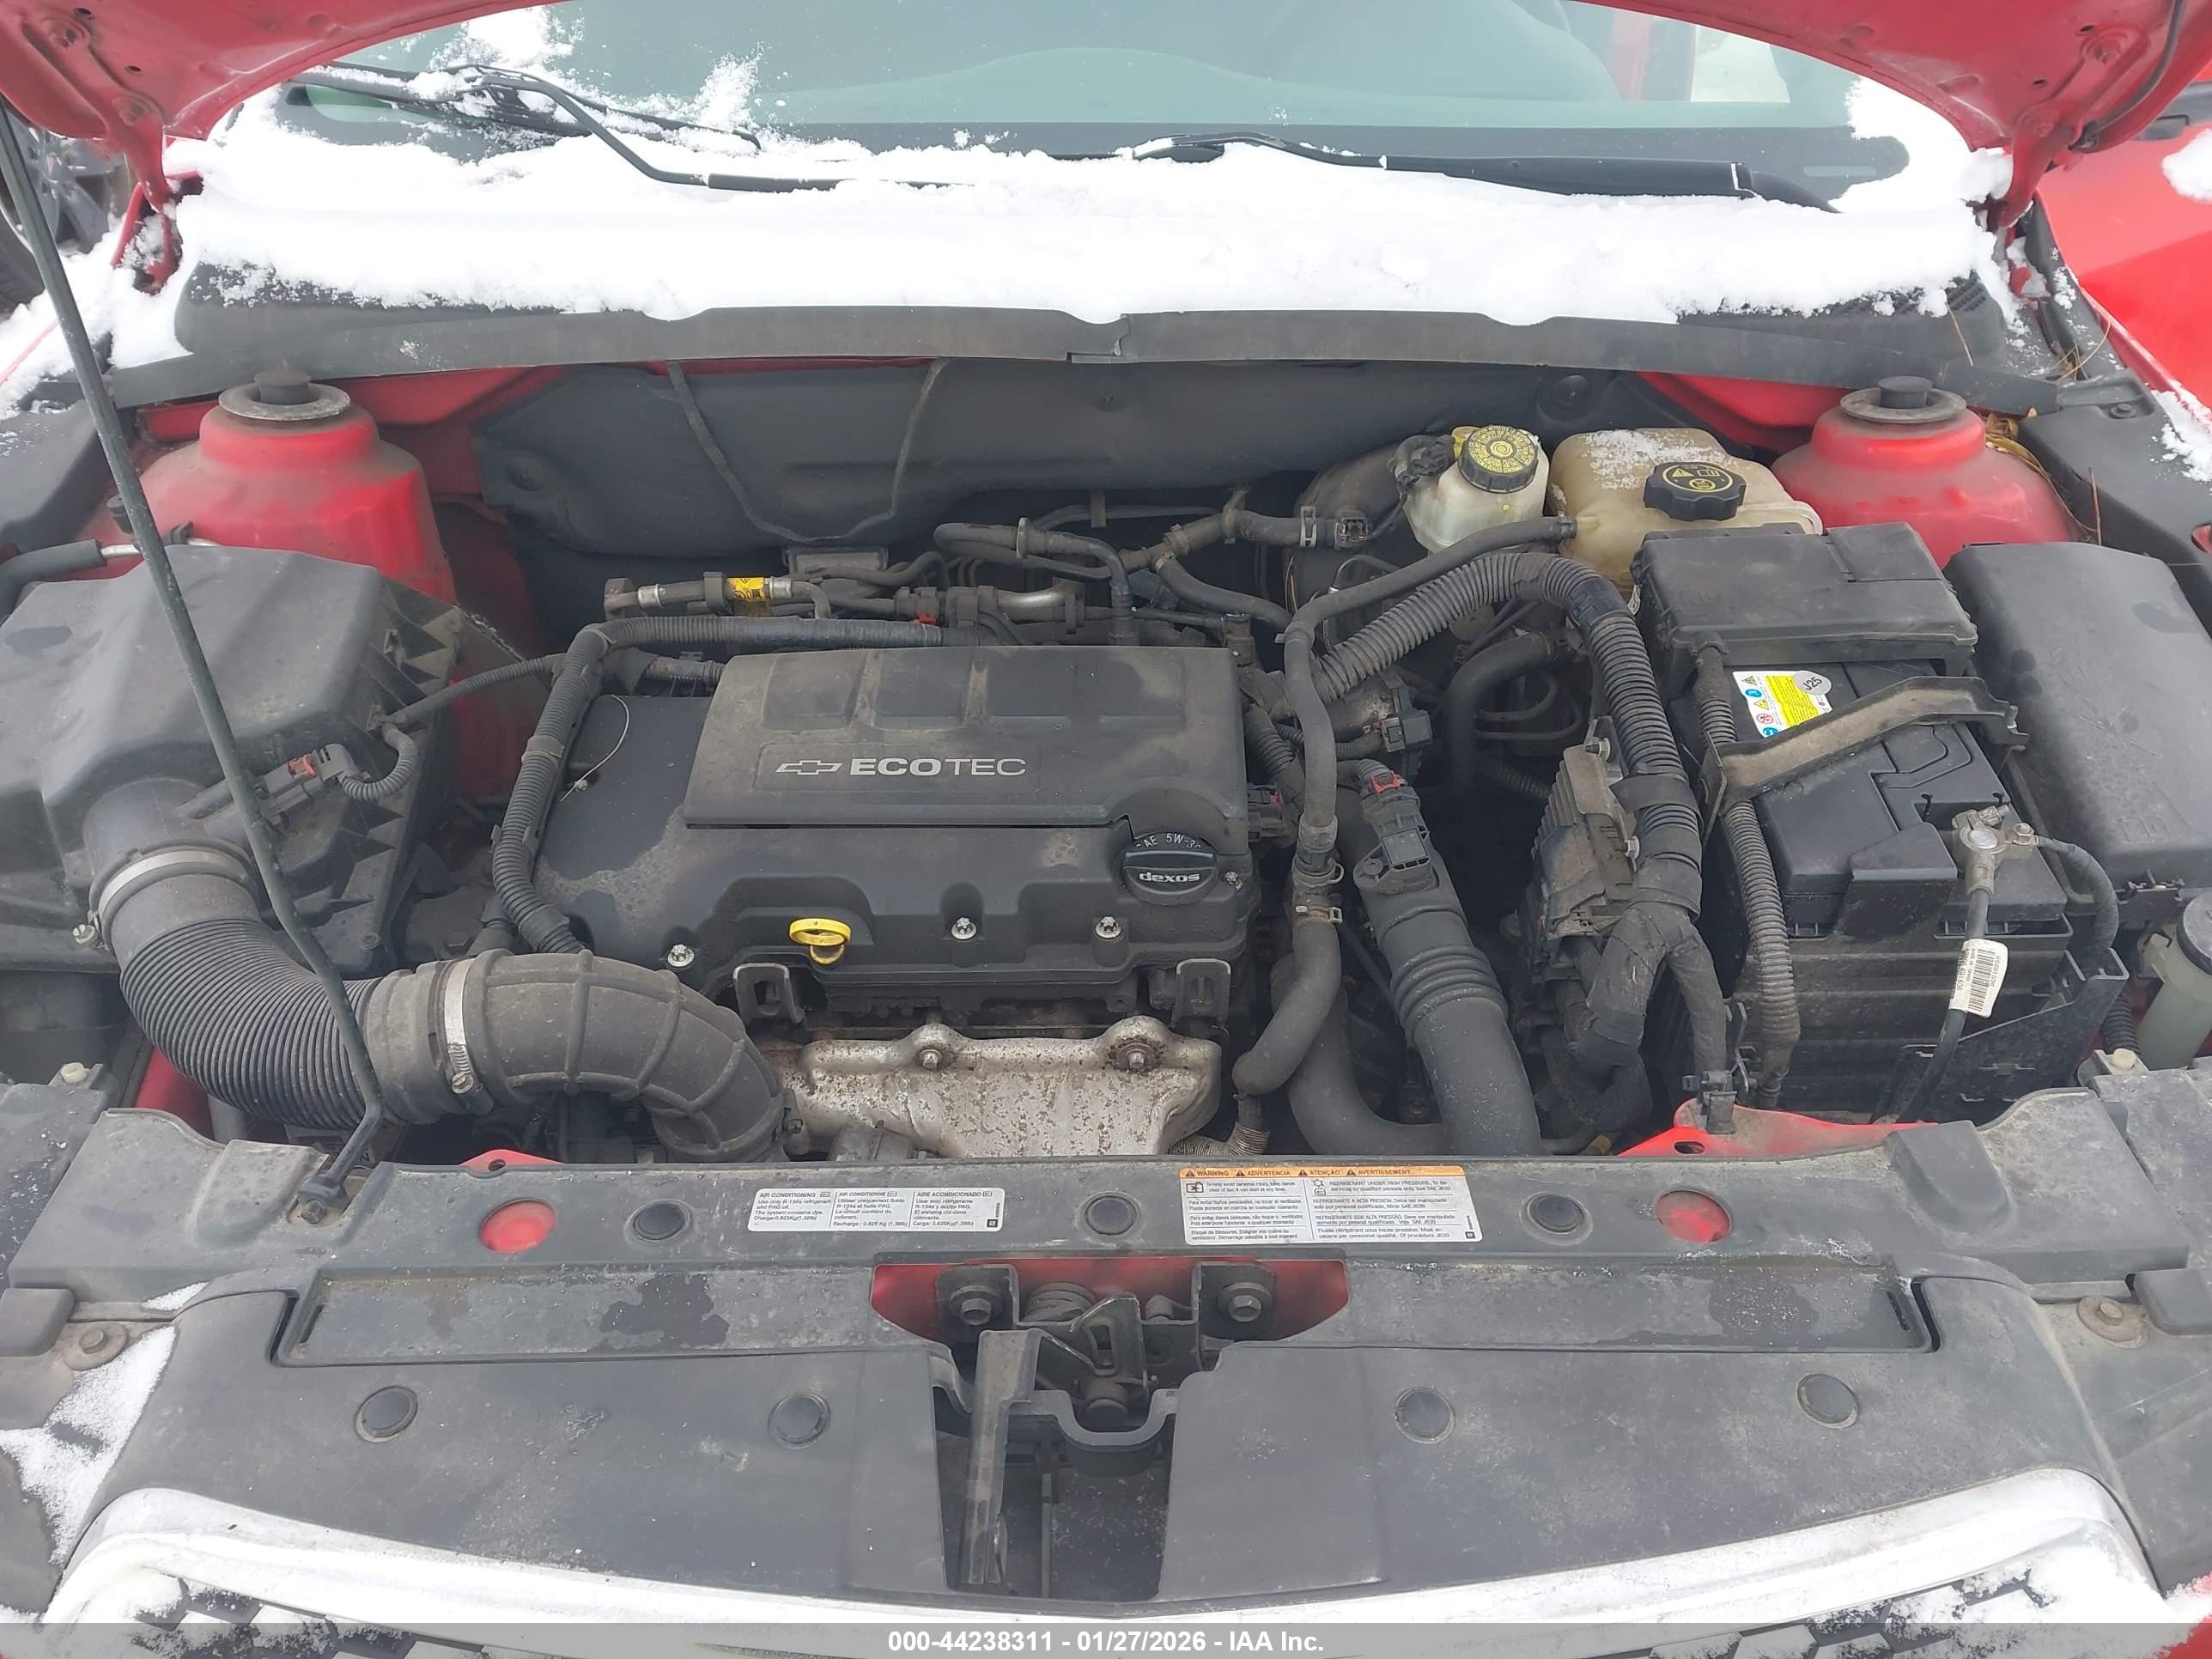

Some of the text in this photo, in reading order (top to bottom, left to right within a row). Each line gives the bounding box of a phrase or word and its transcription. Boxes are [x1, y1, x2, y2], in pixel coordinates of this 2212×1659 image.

[1802, 676, 1822, 690] J25
[850, 757, 1026, 775] ECOTEC
[1139, 872, 1200, 883] dexos
[1310, 1168, 1340, 1177] ATENÇÃO
